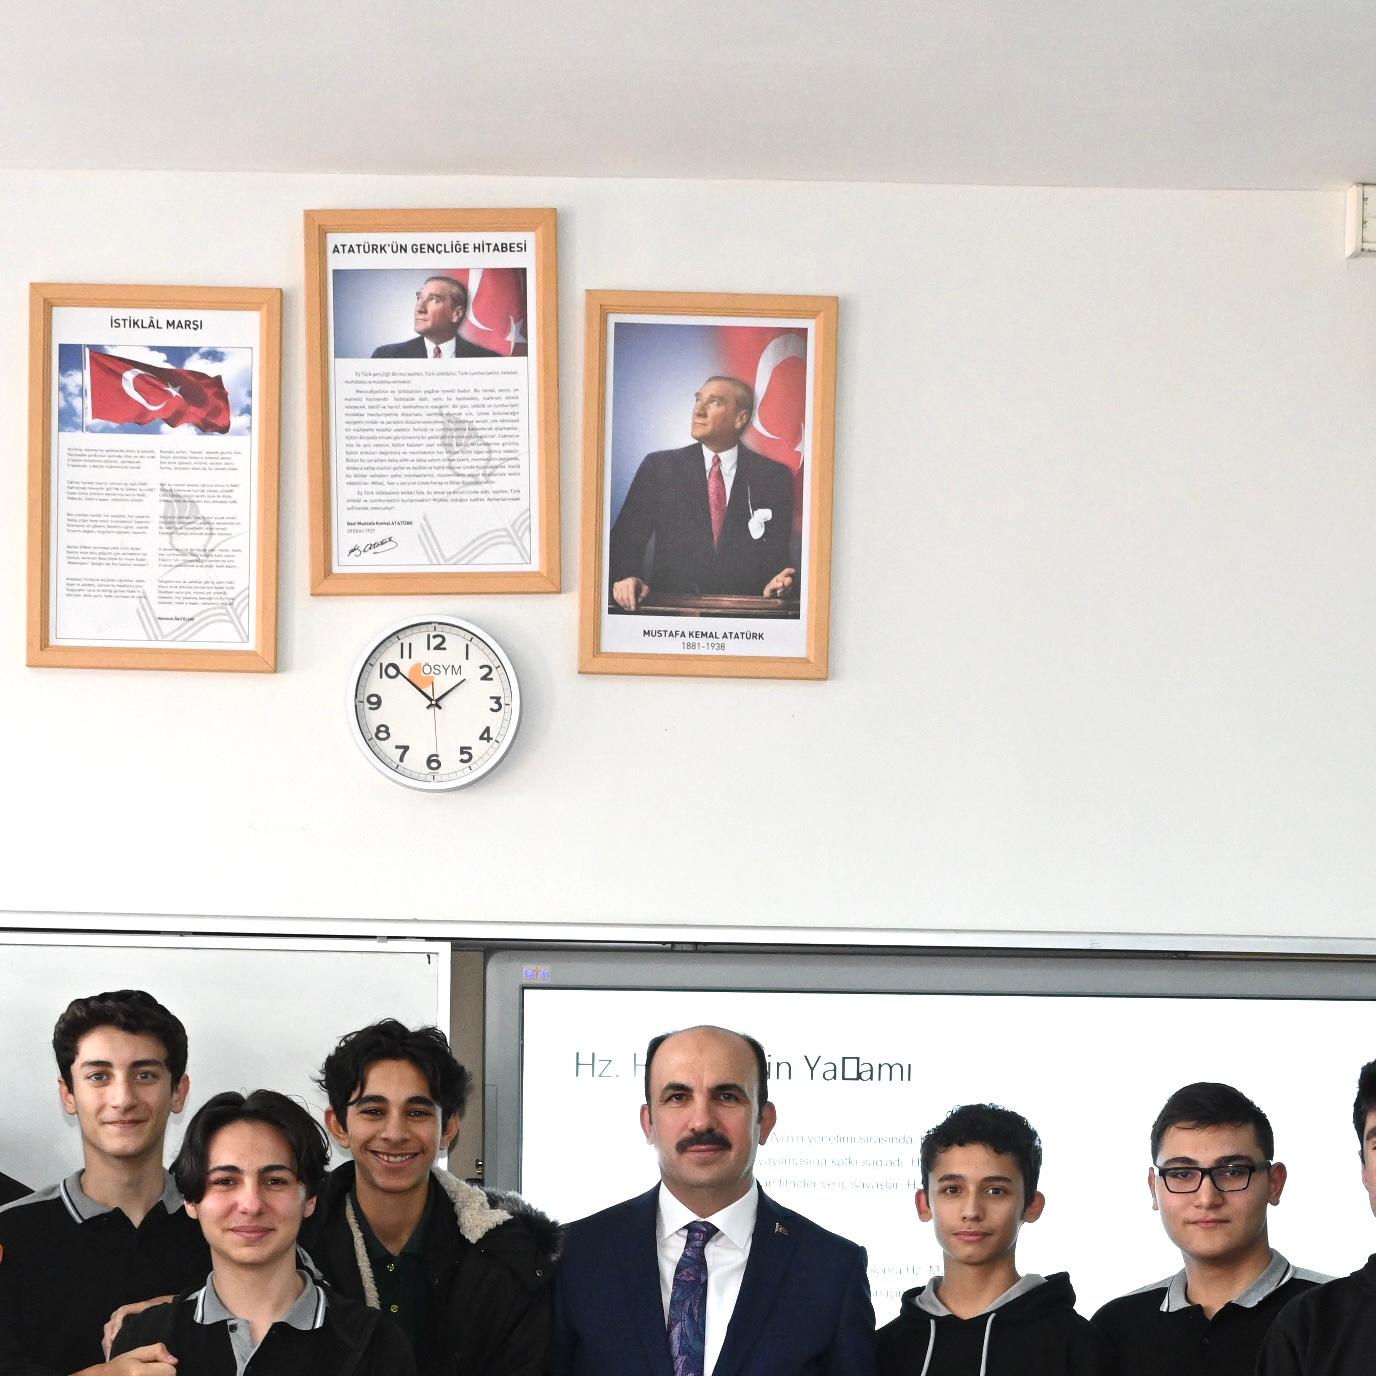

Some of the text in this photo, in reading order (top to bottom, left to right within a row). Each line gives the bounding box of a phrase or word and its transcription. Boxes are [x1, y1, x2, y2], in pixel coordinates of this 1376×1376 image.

[332, 240, 527, 255] ATATÜRK'ÜN GENÇLİĞE HİTABESİ
[110, 315, 203, 331] İSTİKLÂL MARŞI
[427, 634, 447, 650] 12
[643, 629, 765, 640] MUSTAFA KEMAL ATATÜRK
[400, 642, 412, 659] 11
[465, 644, 469, 660] 1
[682, 642, 726, 651] 1881-1938
[379, 662, 400, 679] 10
[422, 663, 462, 676] ÖSYM
[479, 665, 494, 681] 2
[366, 694, 382, 710] 9
[489, 696, 502, 712] 3
[375, 724, 391, 741] 8
[479, 726, 493, 743] 4
[395, 745, 410, 763] 7
[426, 754, 442, 770] 6
[459, 746, 473, 763] 5
[576, 1052, 619, 1078] Hz.
